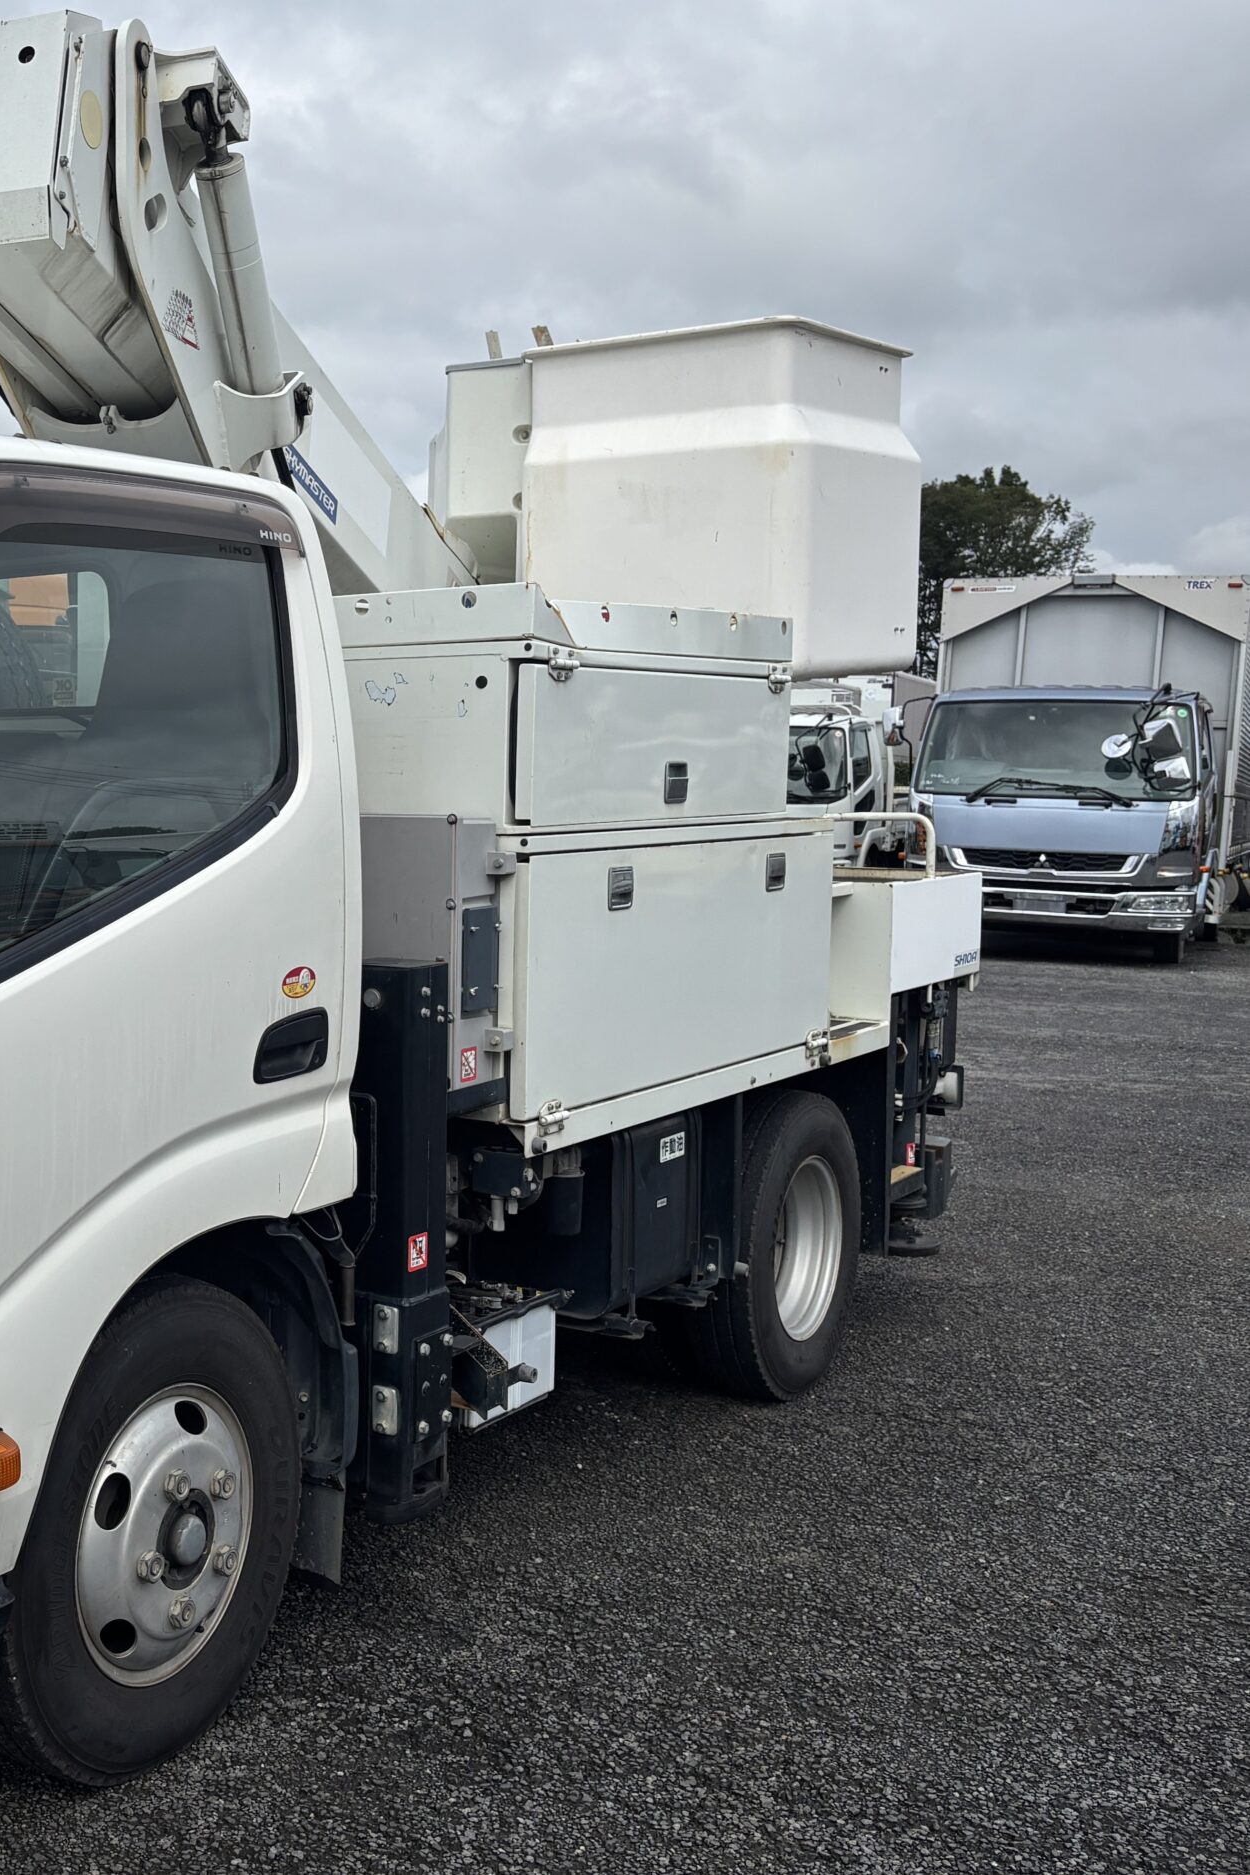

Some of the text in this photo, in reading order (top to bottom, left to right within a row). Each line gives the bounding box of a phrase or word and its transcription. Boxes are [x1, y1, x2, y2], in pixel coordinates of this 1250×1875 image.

[283, 446, 335, 515] SKYMASTER
[259, 529, 292, 543] HINO
[218, 543, 252, 556] HINO
[1186, 580, 1213, 590] TREX
